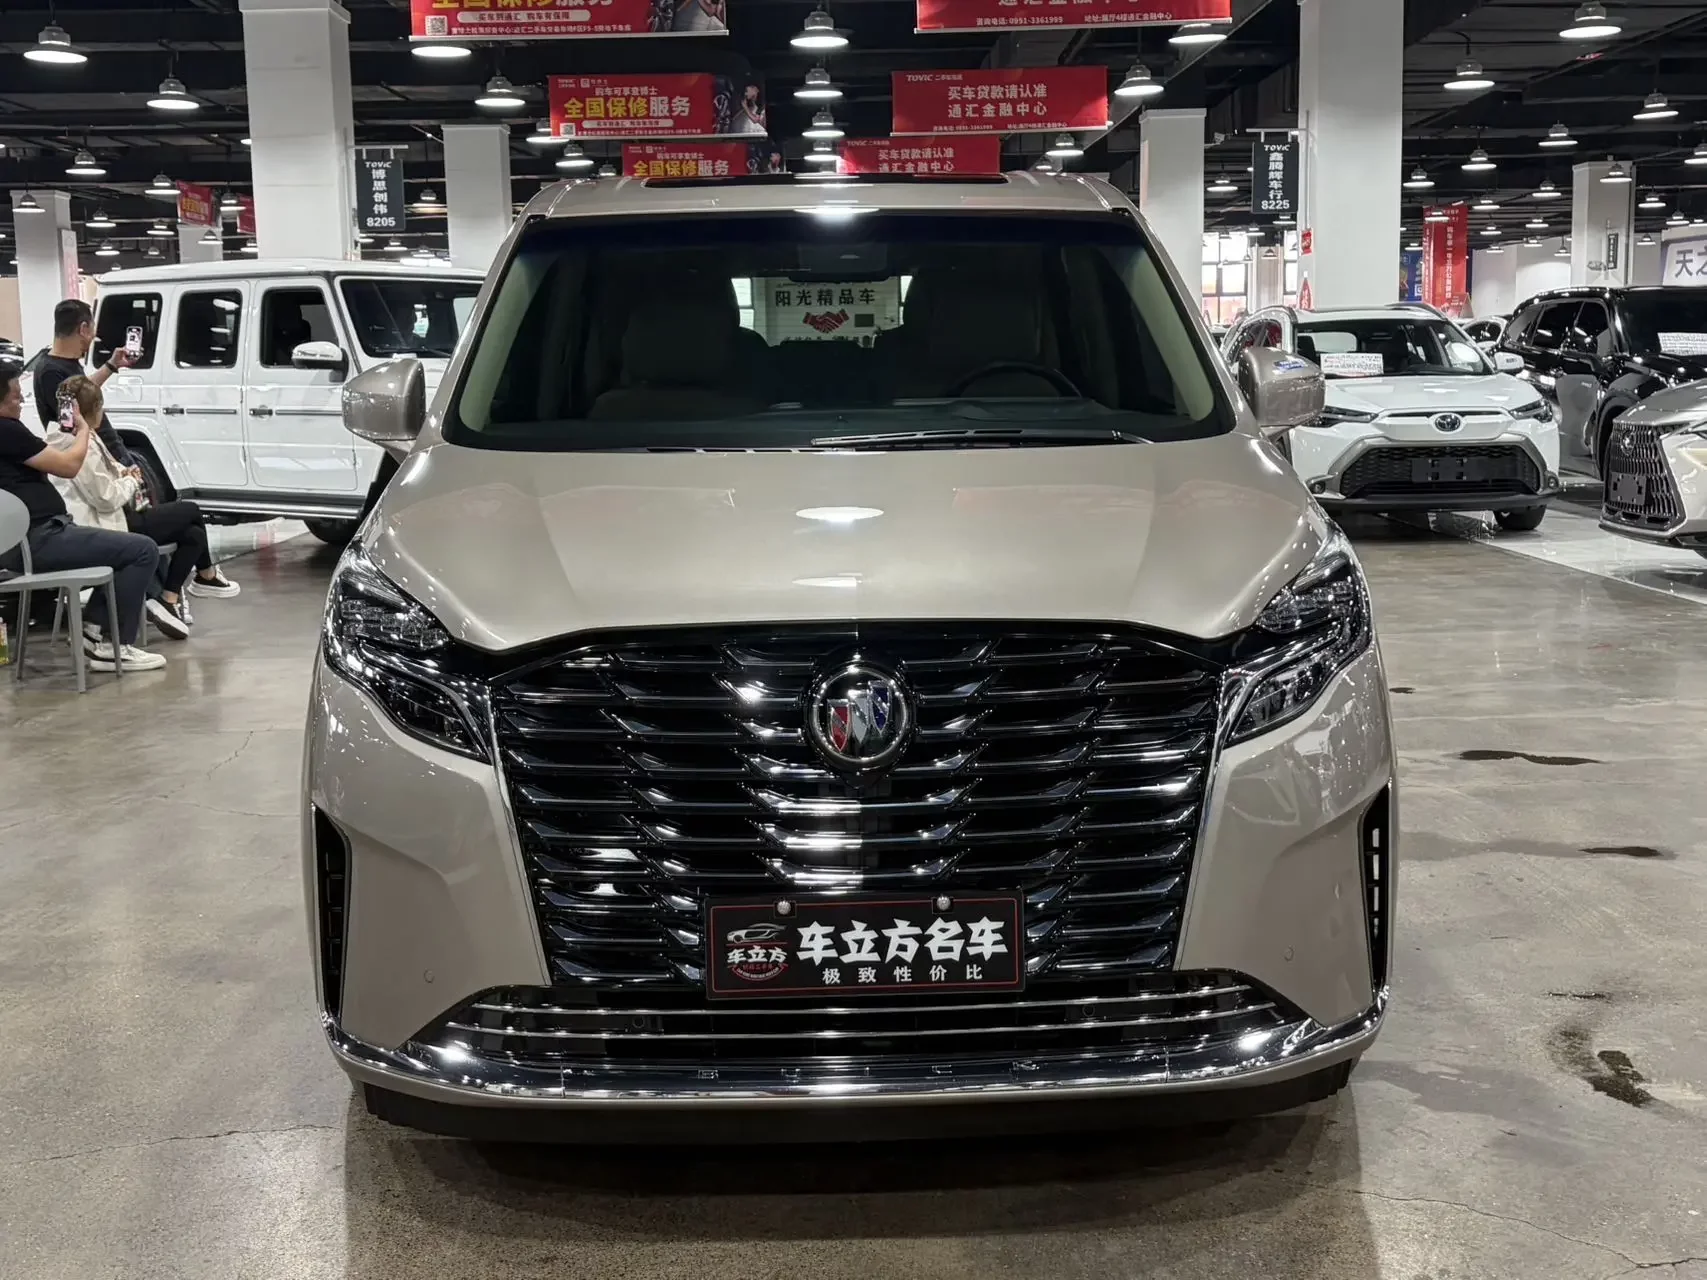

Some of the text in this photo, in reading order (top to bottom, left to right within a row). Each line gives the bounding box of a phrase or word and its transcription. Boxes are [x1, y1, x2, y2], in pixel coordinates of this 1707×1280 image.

[906, 74, 933, 82] TOVIC
[948, 84, 1048, 100] 买车贷款请认准
[564, 96, 690, 118] 全国保修服务
[948, 101, 1048, 118] 通汇金融中心
[878, 147, 954, 160] 买车贷款请认准
[633, 159, 729, 177] 全国保修服务
[878, 160, 954, 173] 通汇金融中心
[1261, 199, 1290, 210] 8225
[366, 216, 396, 227] 8205
[775, 288, 876, 307] 阳光精品车
[796, 916, 1009, 966] 车立方名车
[727, 944, 788, 964] 车立方
[822, 963, 983, 985] 极致性价比
